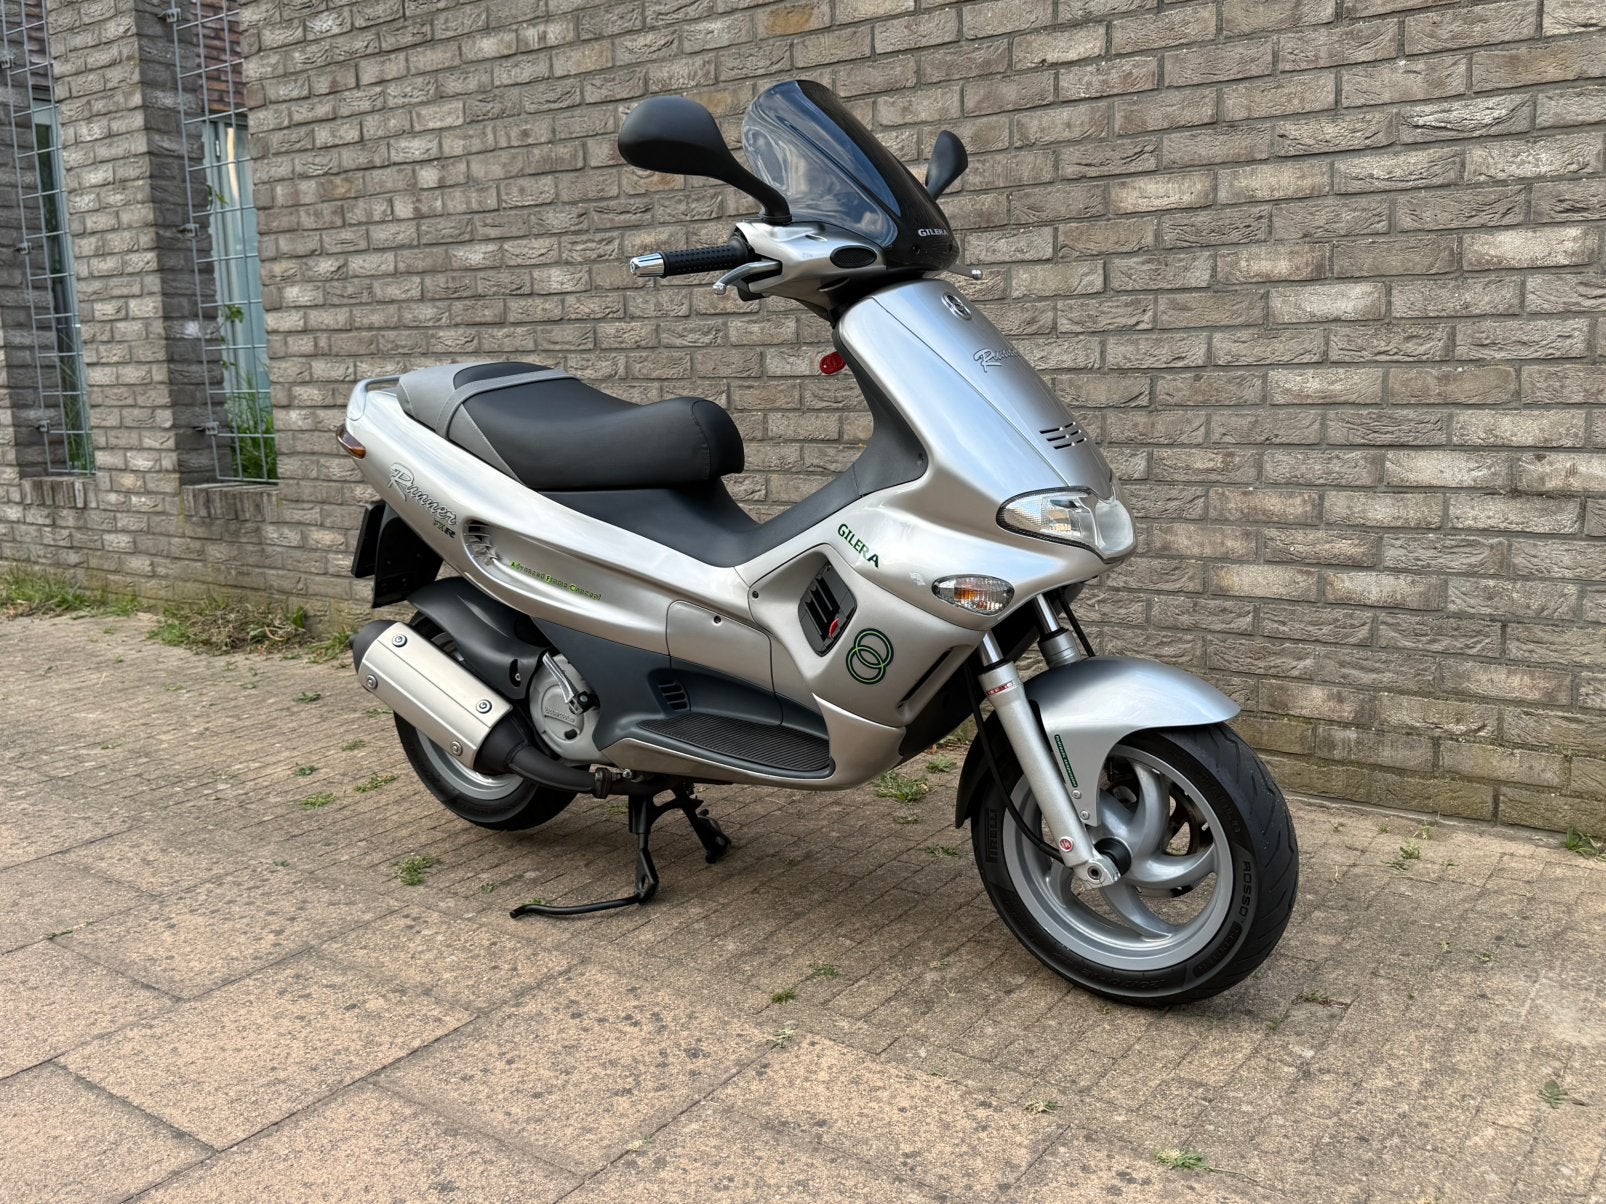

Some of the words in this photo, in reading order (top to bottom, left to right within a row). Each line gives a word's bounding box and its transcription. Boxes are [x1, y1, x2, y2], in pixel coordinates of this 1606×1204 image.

[917, 228, 949, 237] GILERA
[387, 462, 457, 526] Runner
[837, 523, 879, 568] GILERA
[1241, 860, 1252, 918] ROSSO
